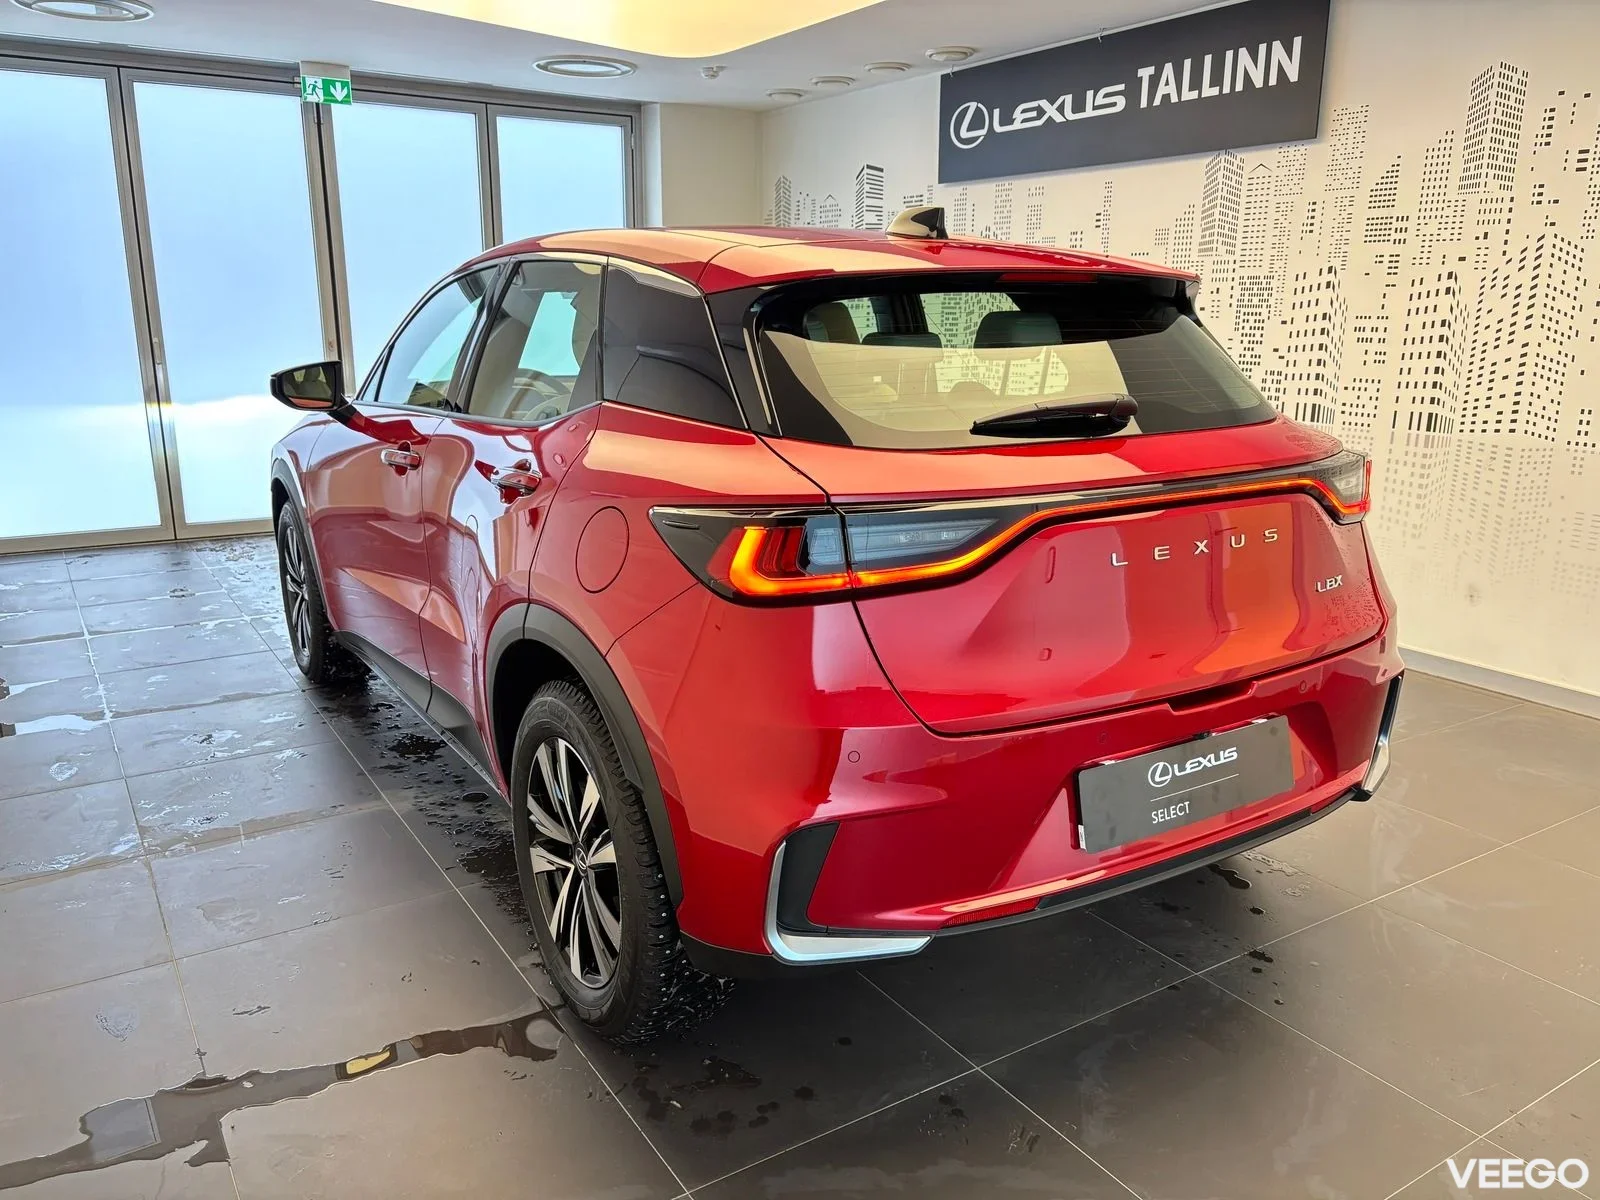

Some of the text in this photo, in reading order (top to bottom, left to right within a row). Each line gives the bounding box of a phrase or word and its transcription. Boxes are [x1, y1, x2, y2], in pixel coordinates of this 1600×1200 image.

[993, 83, 1126, 133] LEXUS
[1137, 36, 1302, 109] TALLINN
[1111, 528, 1278, 567] LEXUS
[1315, 574, 1343, 593] LBX
[1173, 746, 1238, 777] LEXUS
[1151, 801, 1190, 824] SELECT
